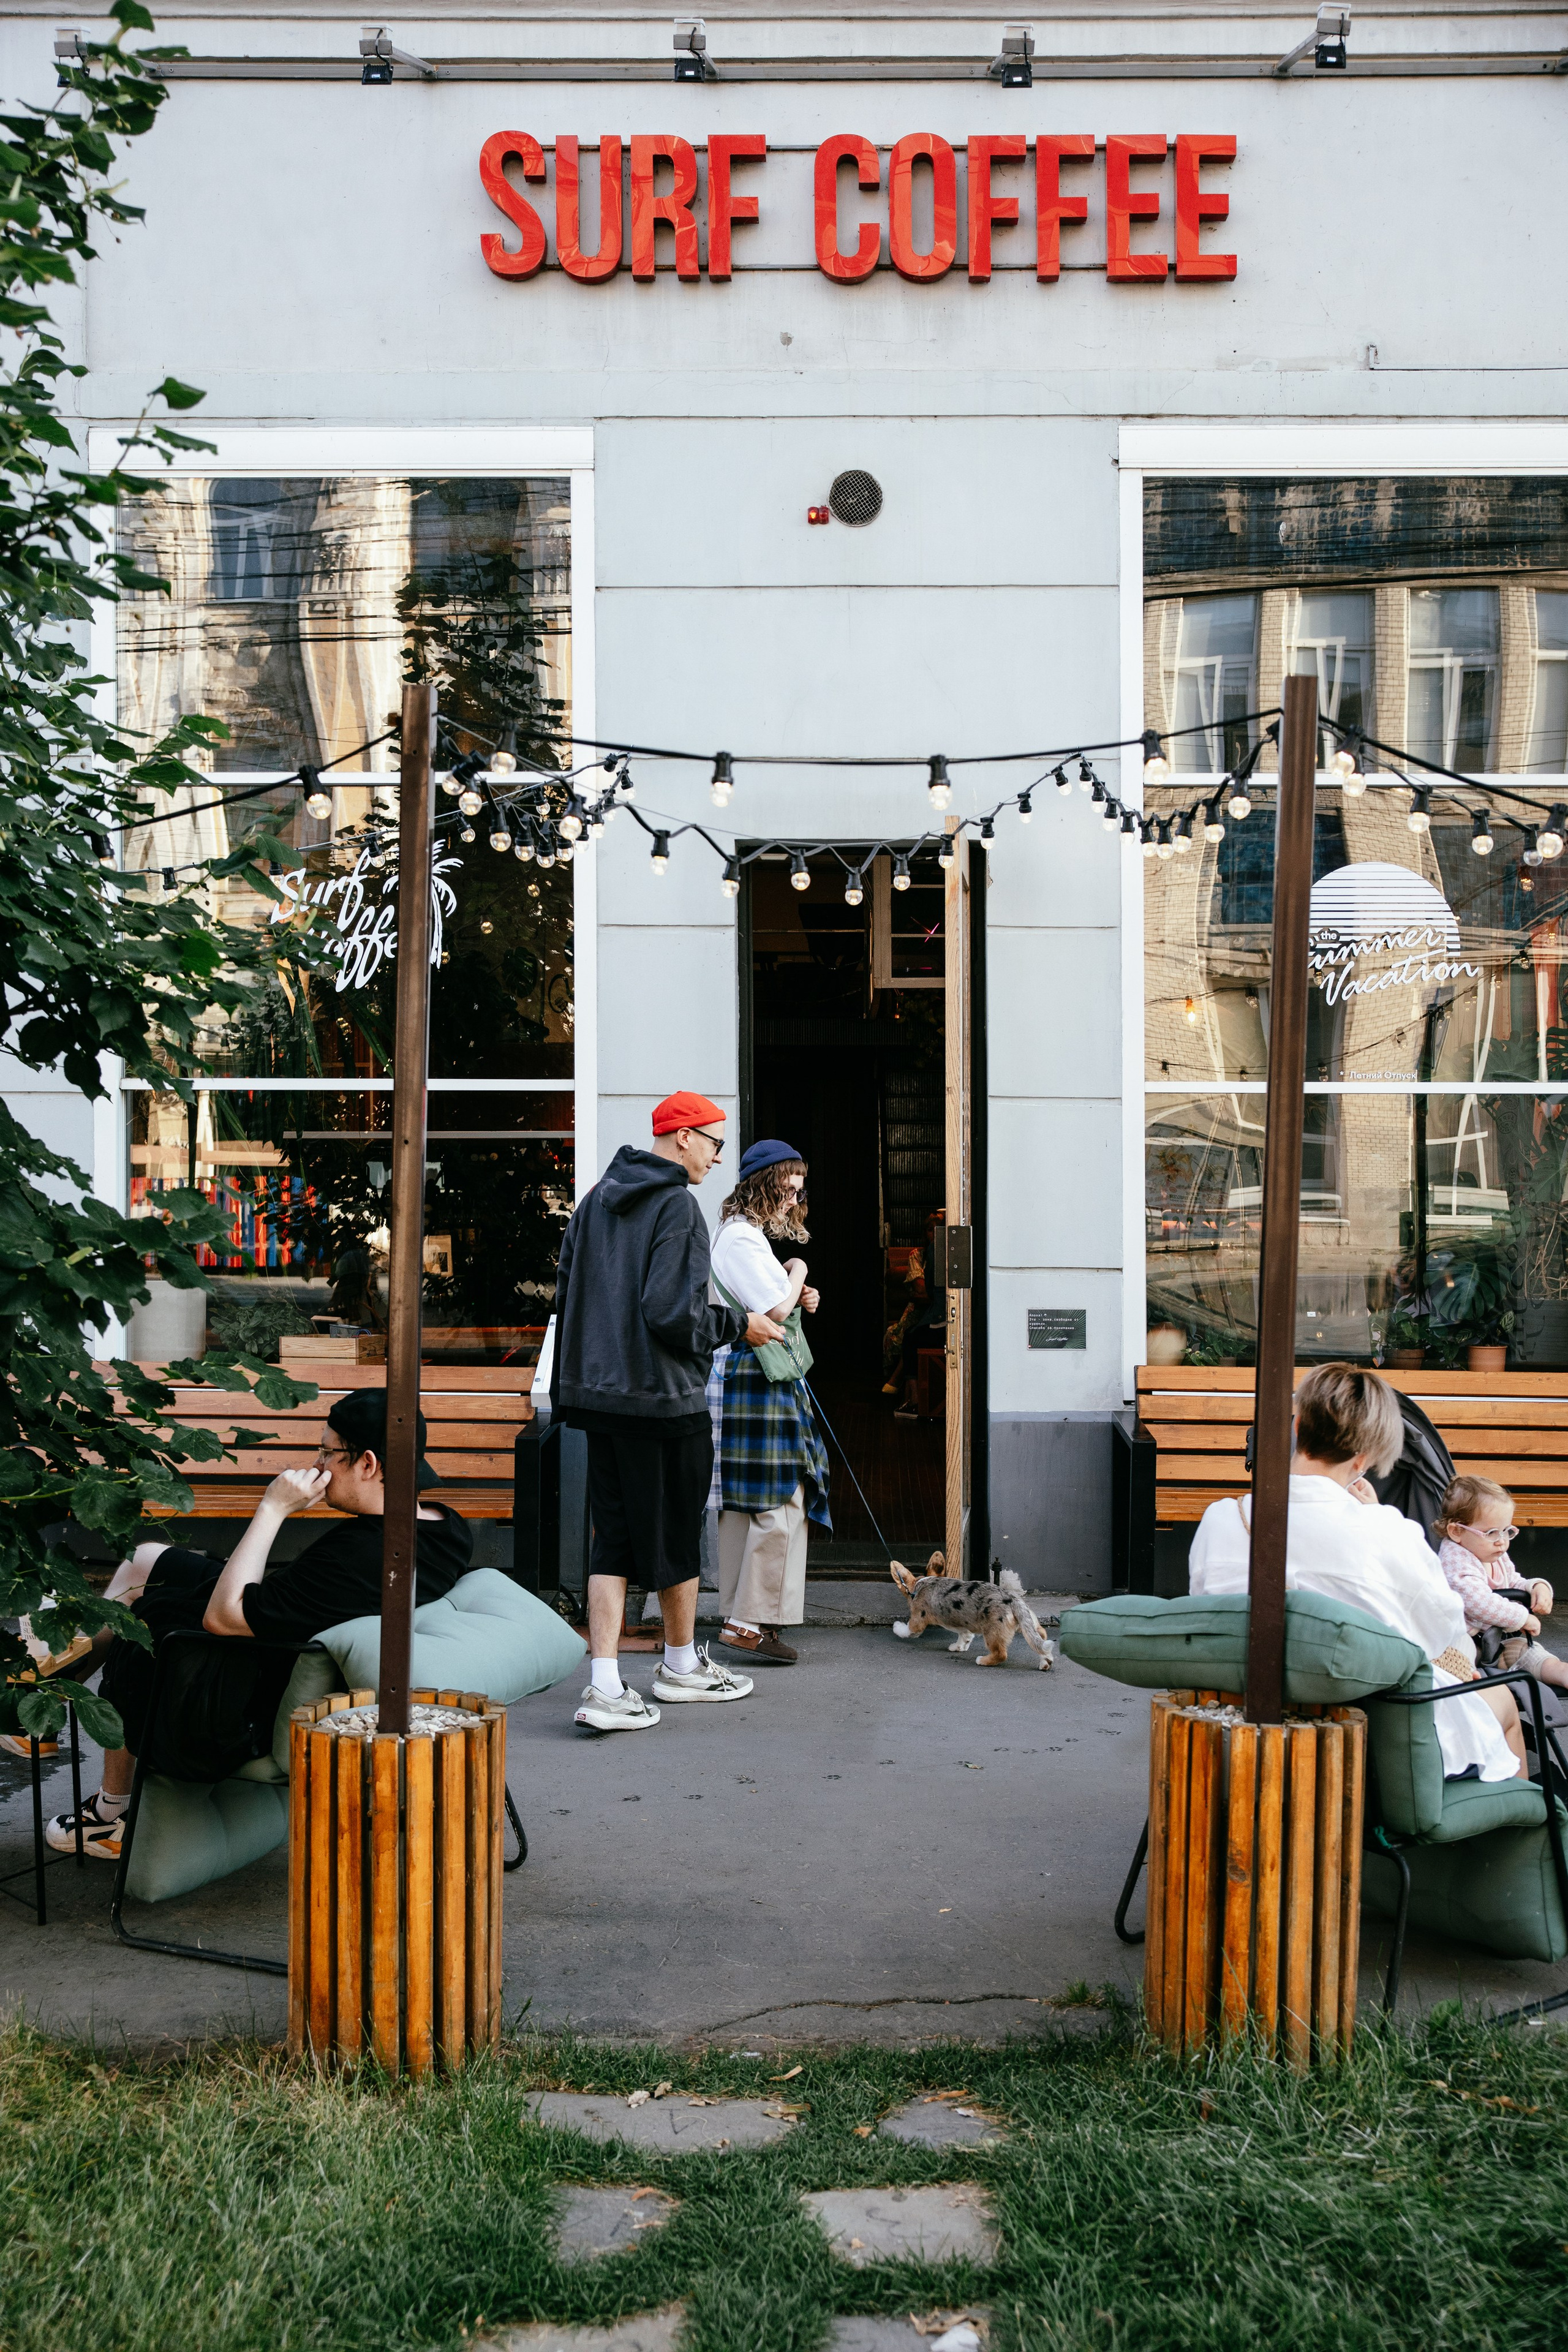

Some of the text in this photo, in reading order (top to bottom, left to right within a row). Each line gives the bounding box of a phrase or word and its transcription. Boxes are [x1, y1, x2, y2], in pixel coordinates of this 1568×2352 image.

[480, 130, 1238, 285] SURF COFFEE
[270, 847, 371, 932] Surf
[1320, 930, 1337, 940] the
[1319, 948, 1479, 1006] Vacation
[1349, 1071, 1416, 1080] Летний Отпуск
